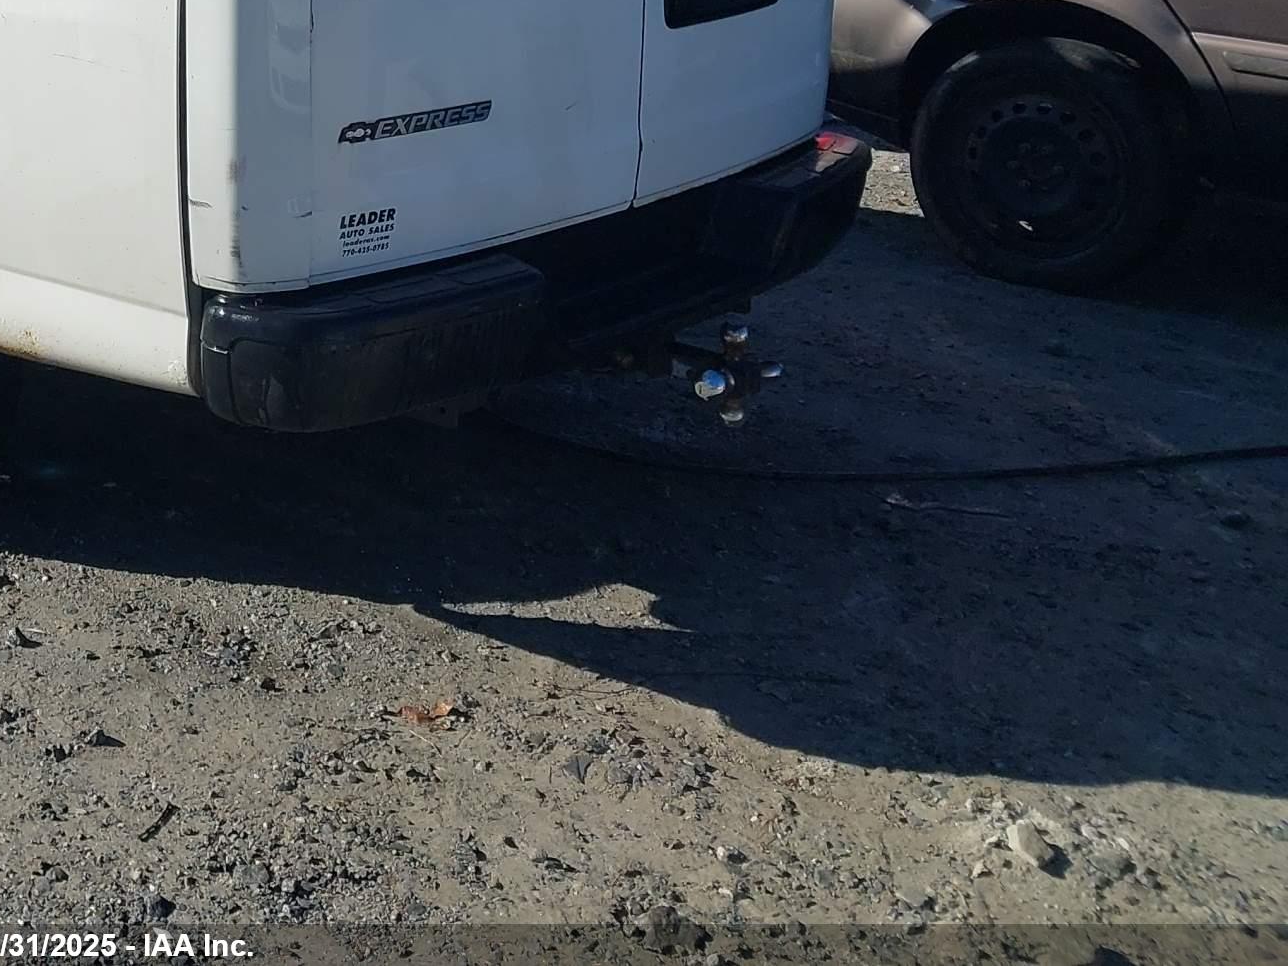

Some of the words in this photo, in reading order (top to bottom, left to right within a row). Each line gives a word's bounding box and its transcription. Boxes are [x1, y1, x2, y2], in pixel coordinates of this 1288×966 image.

[374, 102, 491, 139] EXPRESS
[340, 208, 396, 229] LEADER
[339, 228, 365, 240] AUTO
[368, 223, 394, 235] SALES
